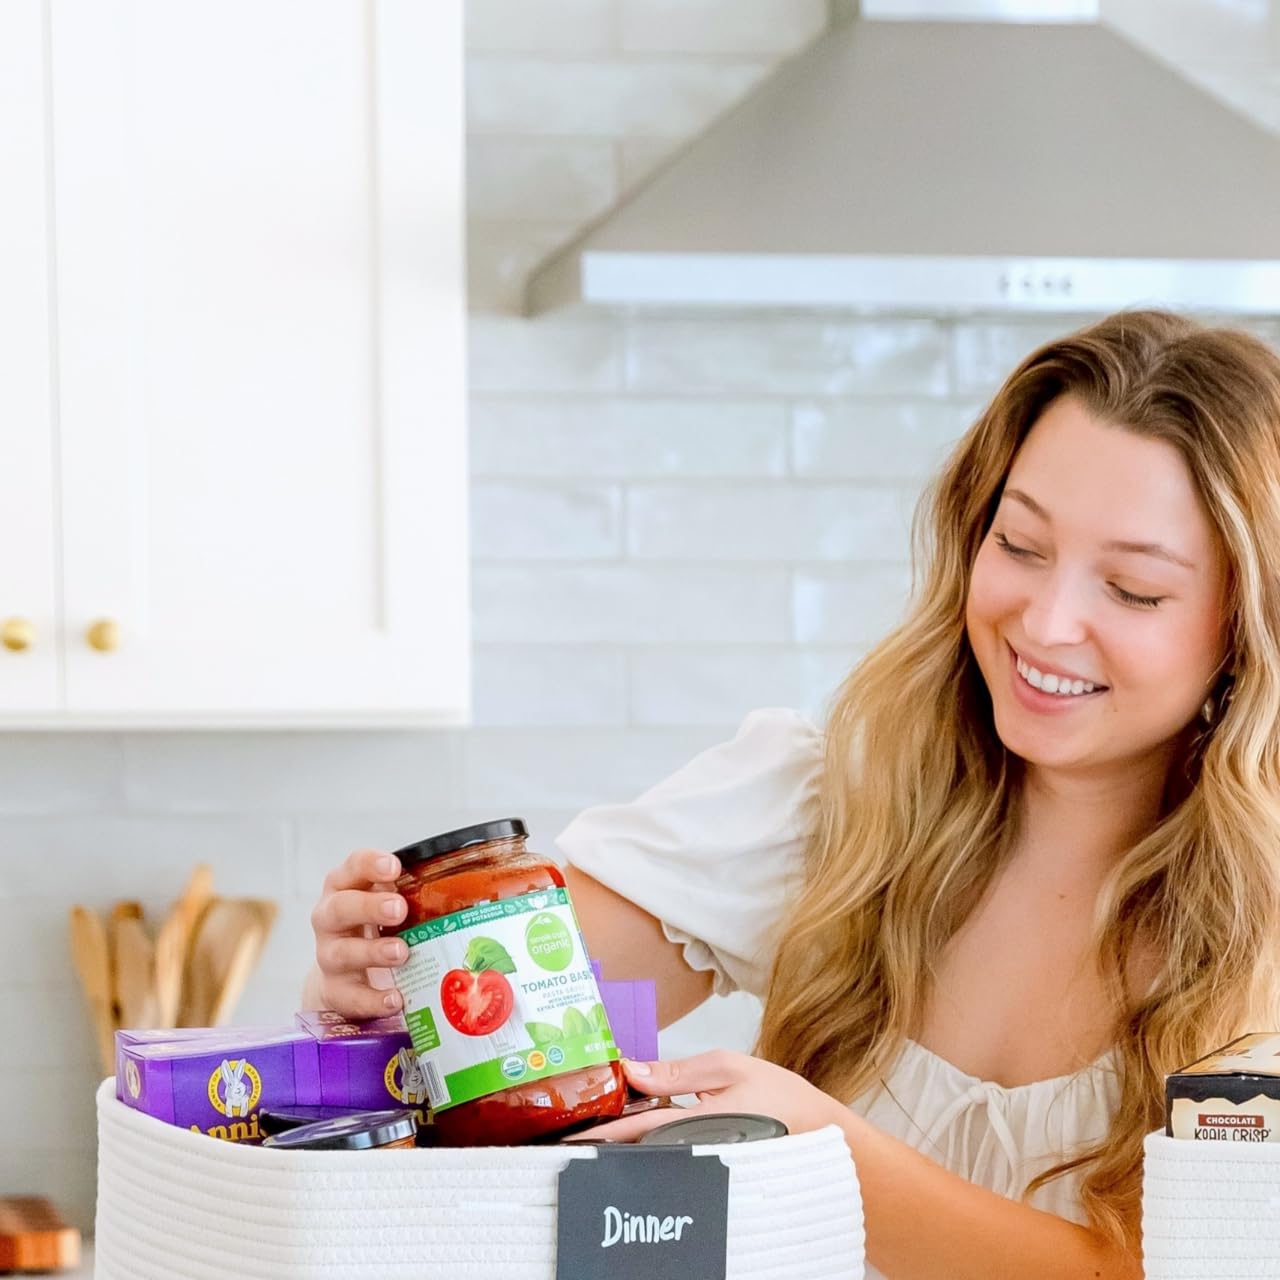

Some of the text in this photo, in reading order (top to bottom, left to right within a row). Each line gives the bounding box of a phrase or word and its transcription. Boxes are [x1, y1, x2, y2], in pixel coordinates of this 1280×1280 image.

[532, 937, 569, 955] organic
[521, 975, 568, 995] TOMATO
[1206, 1116, 1256, 1125] CHOCOLATE
[601, 1205, 694, 1248] Dinner
